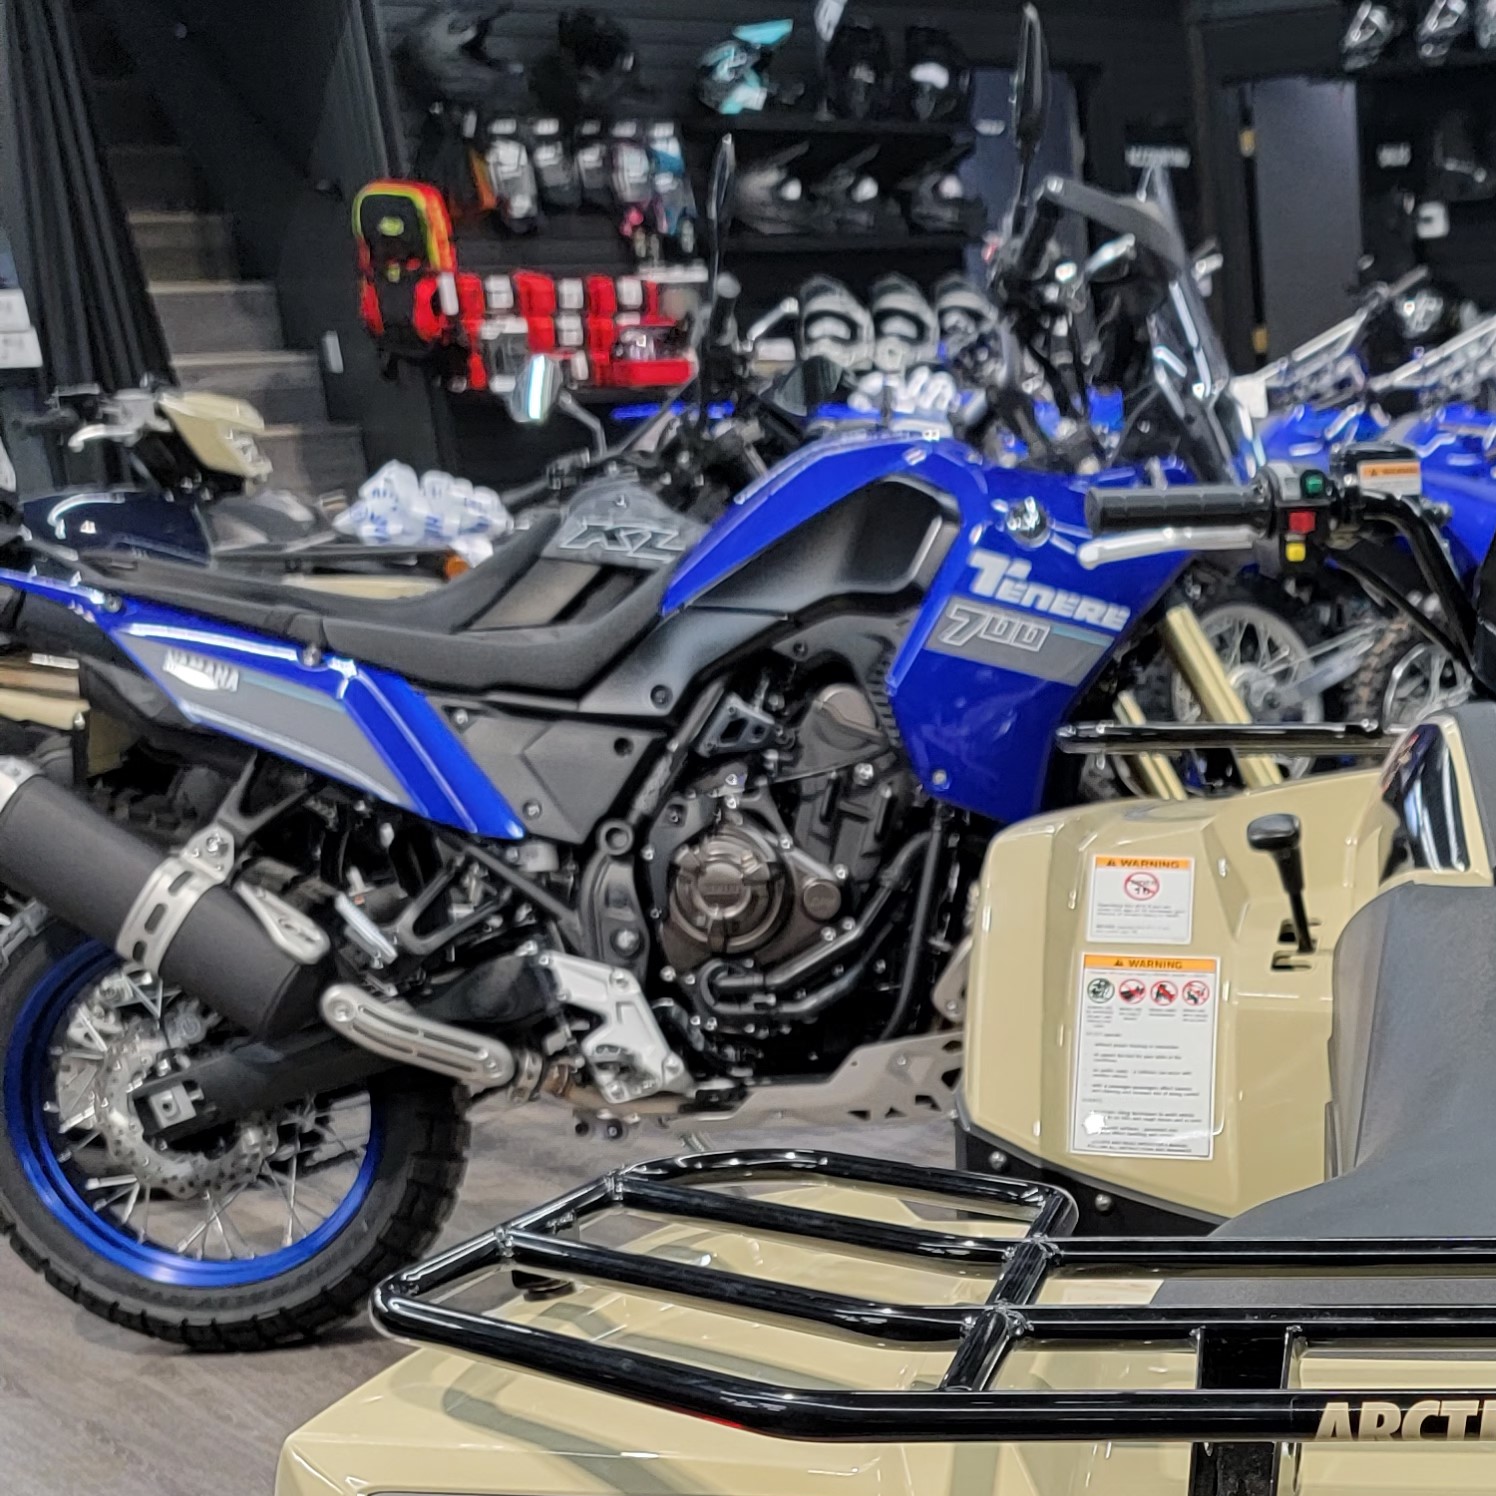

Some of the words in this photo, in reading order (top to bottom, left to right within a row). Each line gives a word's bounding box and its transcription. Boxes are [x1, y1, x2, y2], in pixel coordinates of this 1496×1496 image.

[940, 604, 1050, 652] 700
[1120, 859, 1180, 869] WARNING
[1128, 959, 1183, 969] WARNING
